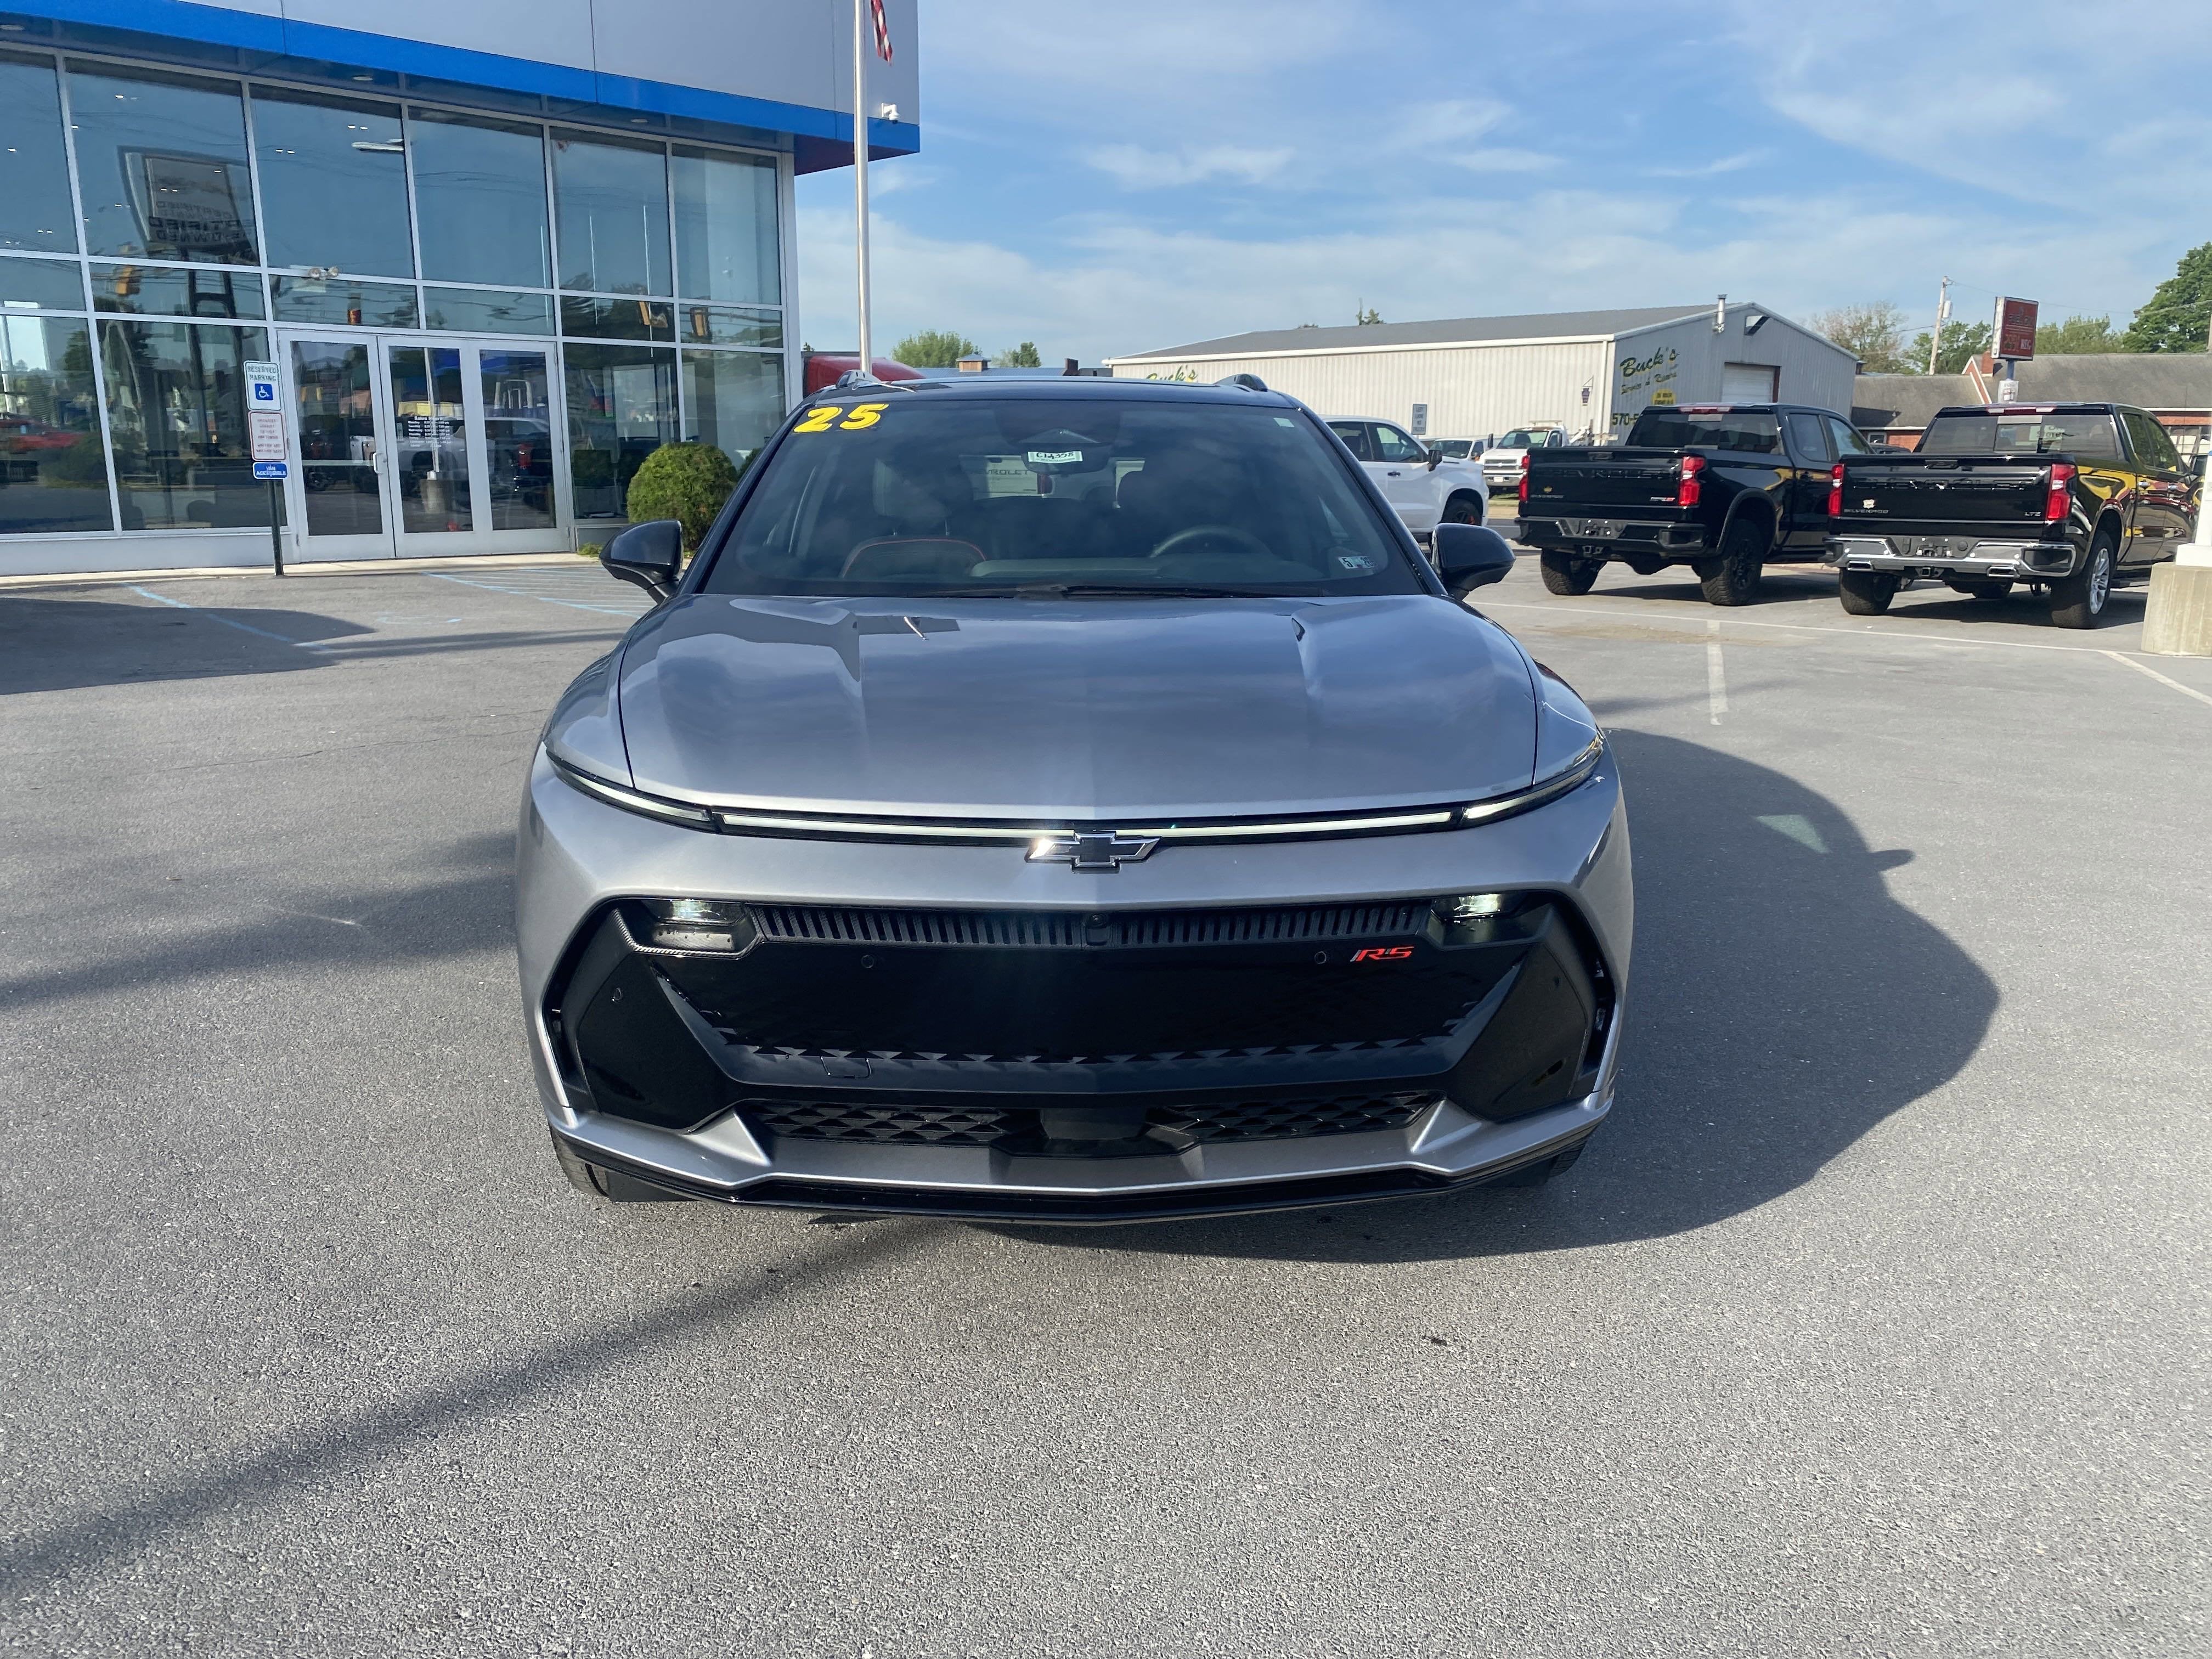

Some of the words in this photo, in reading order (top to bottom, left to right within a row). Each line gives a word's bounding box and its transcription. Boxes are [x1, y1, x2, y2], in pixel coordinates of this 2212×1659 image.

[1620, 347, 1680, 377] Buck's
[794, 404, 889, 432] 25
[1612, 413, 1639, 425] 570-5
[1350, 946, 1414, 962] RS
